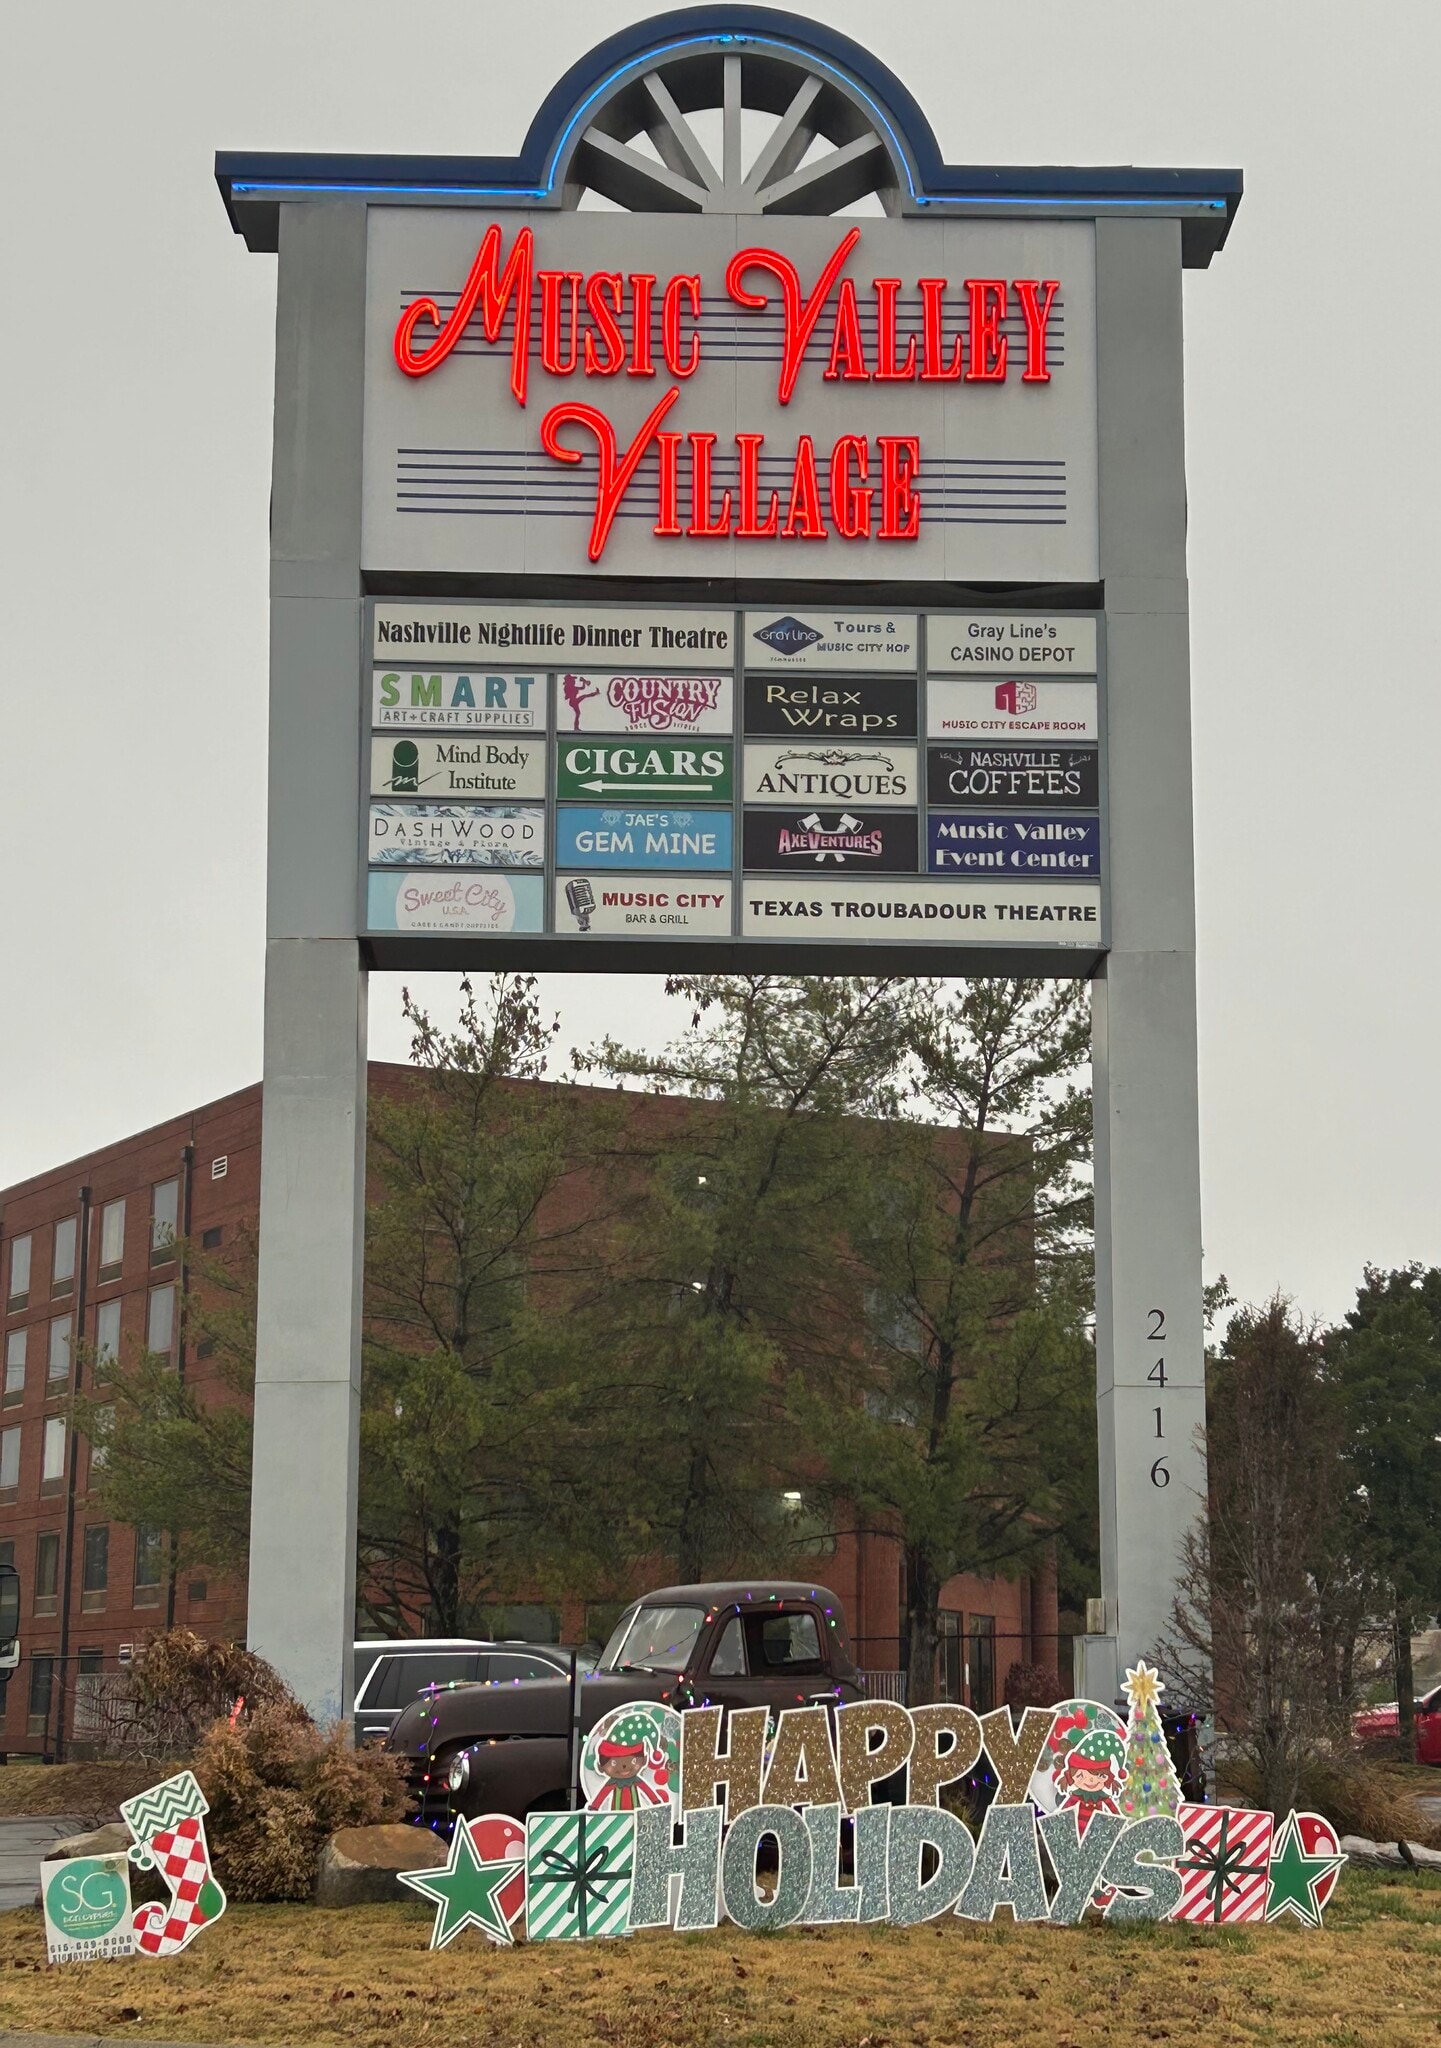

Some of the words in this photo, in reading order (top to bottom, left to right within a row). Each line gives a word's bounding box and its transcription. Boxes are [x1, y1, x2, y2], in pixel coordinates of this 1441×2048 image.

[395, 223, 700, 407] MUSIC
[725, 226, 1060, 405] VALLEY
[540, 386, 920, 562] VILLAGE
[378, 620, 471, 643] Nashville
[478, 621, 565, 647] Nightlife
[572, 624, 642, 648] Dinner
[649, 626, 728, 649] Theatre
[759, 629, 791, 641] Gray
[834, 621, 882, 633] Tours
[886, 621, 896, 633] &
[968, 623, 1004, 641] Gray
[1010, 624, 1057, 638] Line's
[816, 642, 853, 652] MUSIC
[857, 643, 883, 652] CITY
[886, 643, 910, 653] HOP
[950, 646, 1014, 662] CASINO
[1020, 647, 1075, 663] DEPOT
[380, 673, 534, 708] SMART
[607, 677, 721, 709] COUNTRY
[766, 685, 861, 705] Relax
[466, 712, 530, 724] SUPPLIES
[781, 708, 898, 731] Wraps
[942, 720, 978, 729] MUSIC
[981, 721, 1007, 729] CITY
[1009, 721, 1050, 730] ESCAPE
[1052, 722, 1086, 730] ROOM
[436, 744, 481, 764] Mind
[485, 745, 529, 769] Body
[565, 748, 724, 777] CIGARS
[970, 752, 1060, 768] NASHVILLE
[448, 770, 516, 790] Institute
[756, 772, 907, 798] ANTIQUES
[949, 769, 1081, 795] COFFEES
[625, 813, 669, 827] JAE'S
[937, 822, 1008, 840] Music
[1014, 823, 1090, 841] Valley
[575, 830, 634, 854] GEM
[645, 831, 716, 855] MINE
[935, 848, 1005, 867] Event
[1010, 849, 1094, 868] Center
[404, 882, 464, 912] Sweet
[465, 883, 507, 921] City
[602, 892, 669, 908] MUSIC
[676, 893, 725, 908] CITY
[625, 913, 648, 924] BAR
[649, 913, 657, 924] &
[660, 914, 689, 925] GRILL
[749, 900, 823, 917] TEXAS
[831, 902, 987, 920] TROUBADOUR
[994, 904, 1097, 922] THEATRE
[681, 1699, 1058, 1825] HAPPY
[627, 1801, 1186, 1932] HOLIDAYS
